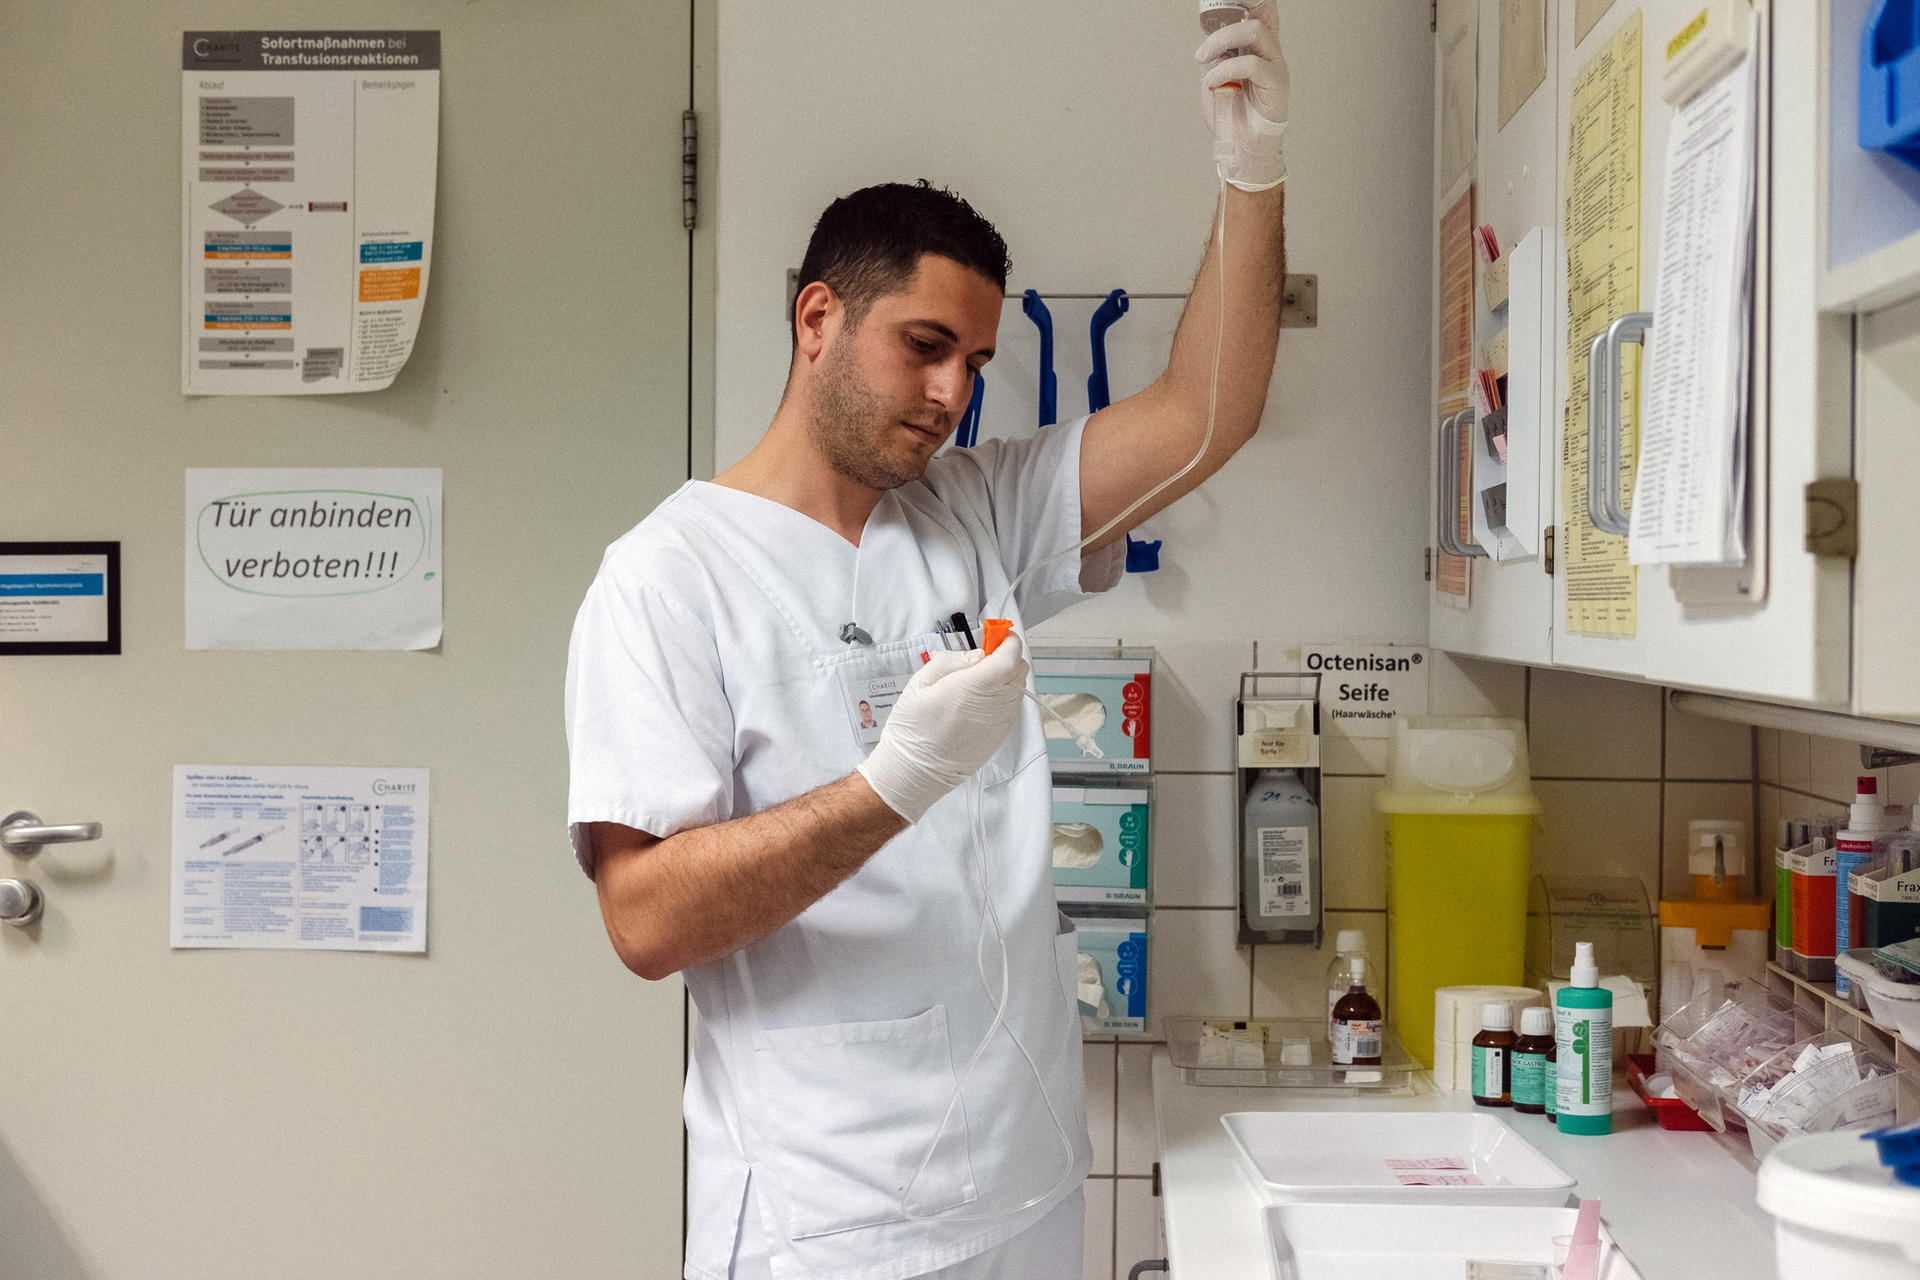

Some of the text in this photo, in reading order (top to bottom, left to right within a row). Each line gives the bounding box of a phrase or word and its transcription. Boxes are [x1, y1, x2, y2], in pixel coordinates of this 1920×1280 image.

[261, 37, 407, 50] Sofortmaßnahmen bei
[261, 53, 419, 65] Transfusionsreaktionen
[212, 501, 412, 528] Tür anbinden
[225, 551, 398, 579] verboten!!!
[1339, 683, 1389, 701] Seife
